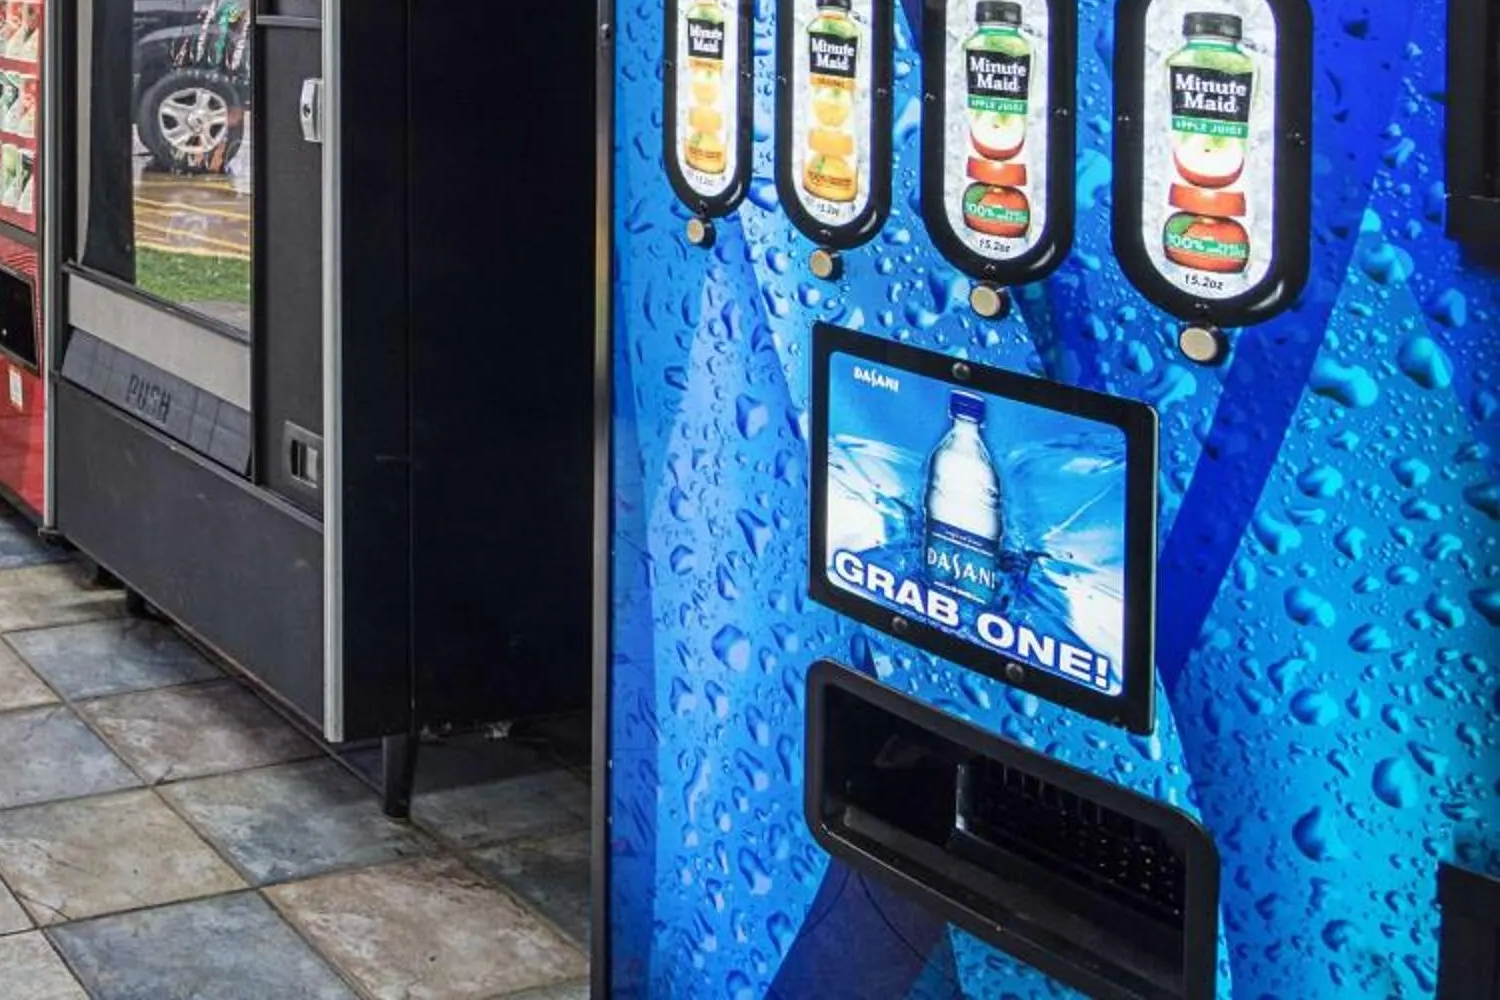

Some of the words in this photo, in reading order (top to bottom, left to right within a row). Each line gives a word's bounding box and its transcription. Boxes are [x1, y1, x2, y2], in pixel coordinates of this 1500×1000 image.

[811, 37, 855, 57] Minute
[816, 53, 850, 71] Maid
[970, 55, 1027, 77] Minute
[977, 73, 1020, 93] Maid
[1175, 73, 1247, 96] Minute
[1183, 92, 1238, 113] Maid
[853, 365, 900, 393] DASANI
[126, 374, 171, 424] PUSH
[927, 547, 996, 590] DASANI
[834, 551, 960, 628] GRAB
[976, 612, 1112, 690] ONE!
